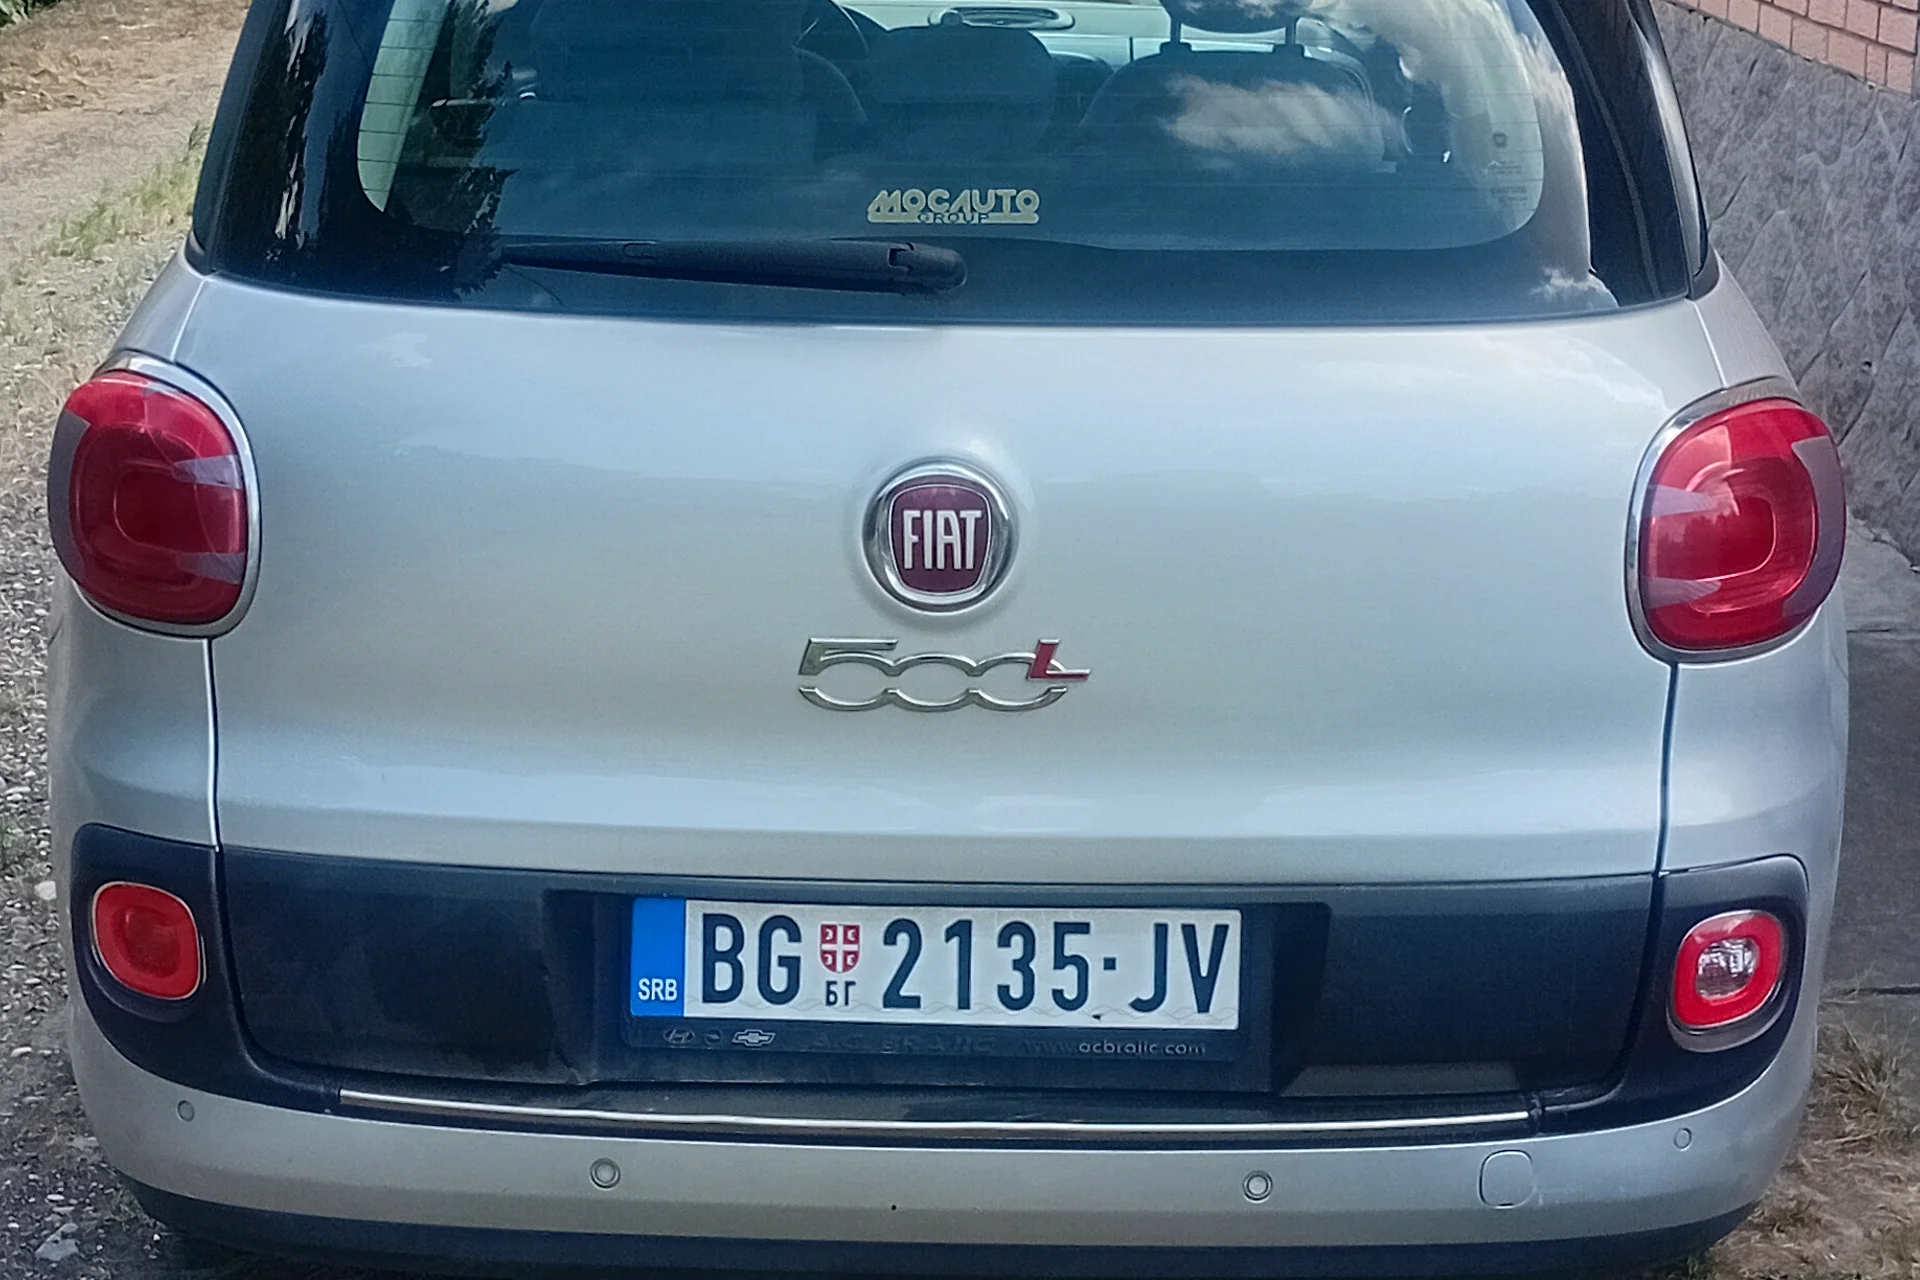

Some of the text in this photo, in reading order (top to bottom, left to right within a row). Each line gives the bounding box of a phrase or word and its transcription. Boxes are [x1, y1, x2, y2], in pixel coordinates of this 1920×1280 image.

[867, 188, 1040, 214] MOCAUTO
[917, 212, 990, 225] GROUP
[902, 509, 983, 570] FIAT
[798, 637, 1092, 712] 500L
[701, 912, 802, 1005] BG
[637, 977, 678, 1001] SRB
[824, 980, 857, 1007] БГ
